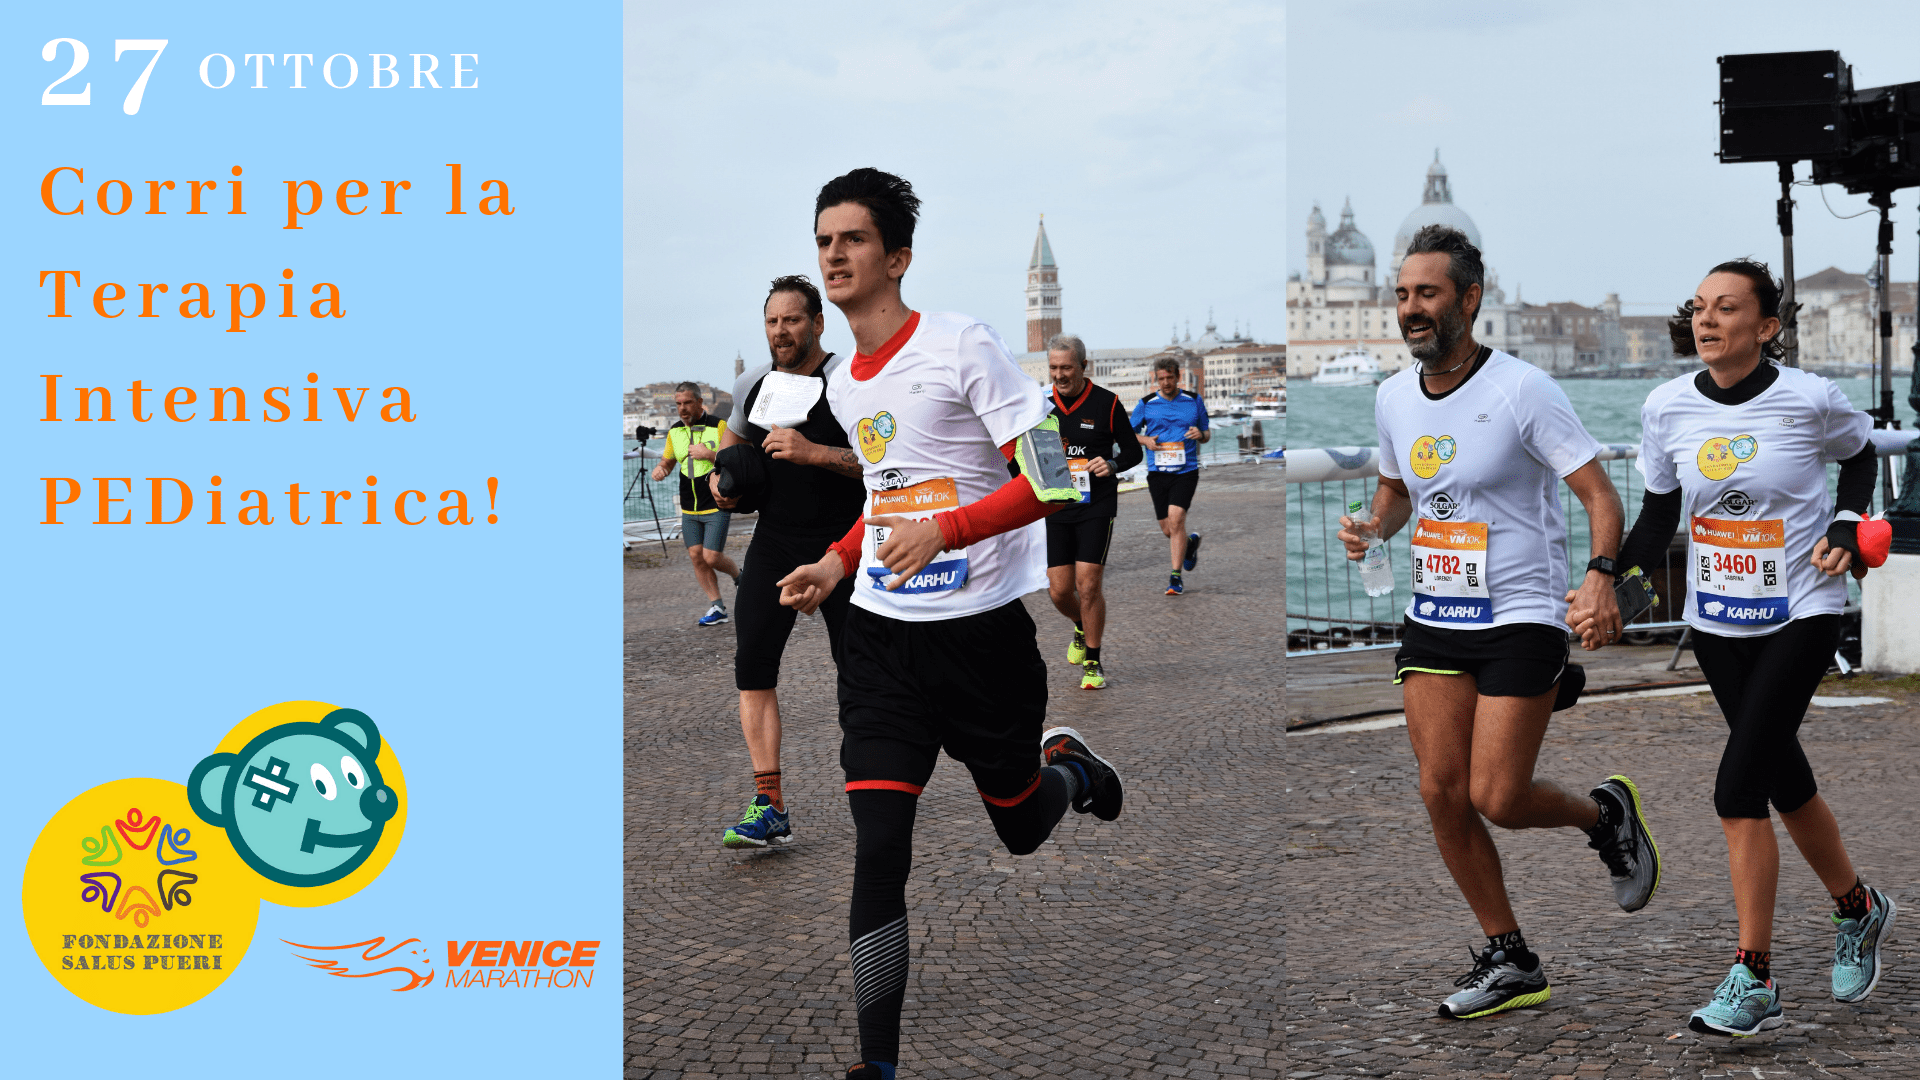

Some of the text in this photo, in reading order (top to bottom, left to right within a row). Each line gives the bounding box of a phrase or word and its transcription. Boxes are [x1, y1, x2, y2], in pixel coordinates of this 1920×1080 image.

[880, 495, 908, 504] HUAWEI
[1422, 531, 1444, 540] HUAWEI
[1707, 529, 1735, 539] HUAWEI
[1426, 554, 1461, 575] 4782
[1713, 552, 1757, 575] 3460
[904, 570, 956, 589] KARHU
[1724, 574, 1745, 582] SABRINA
[1438, 605, 1481, 619] KARHU
[1726, 606, 1775, 620] KARHU
